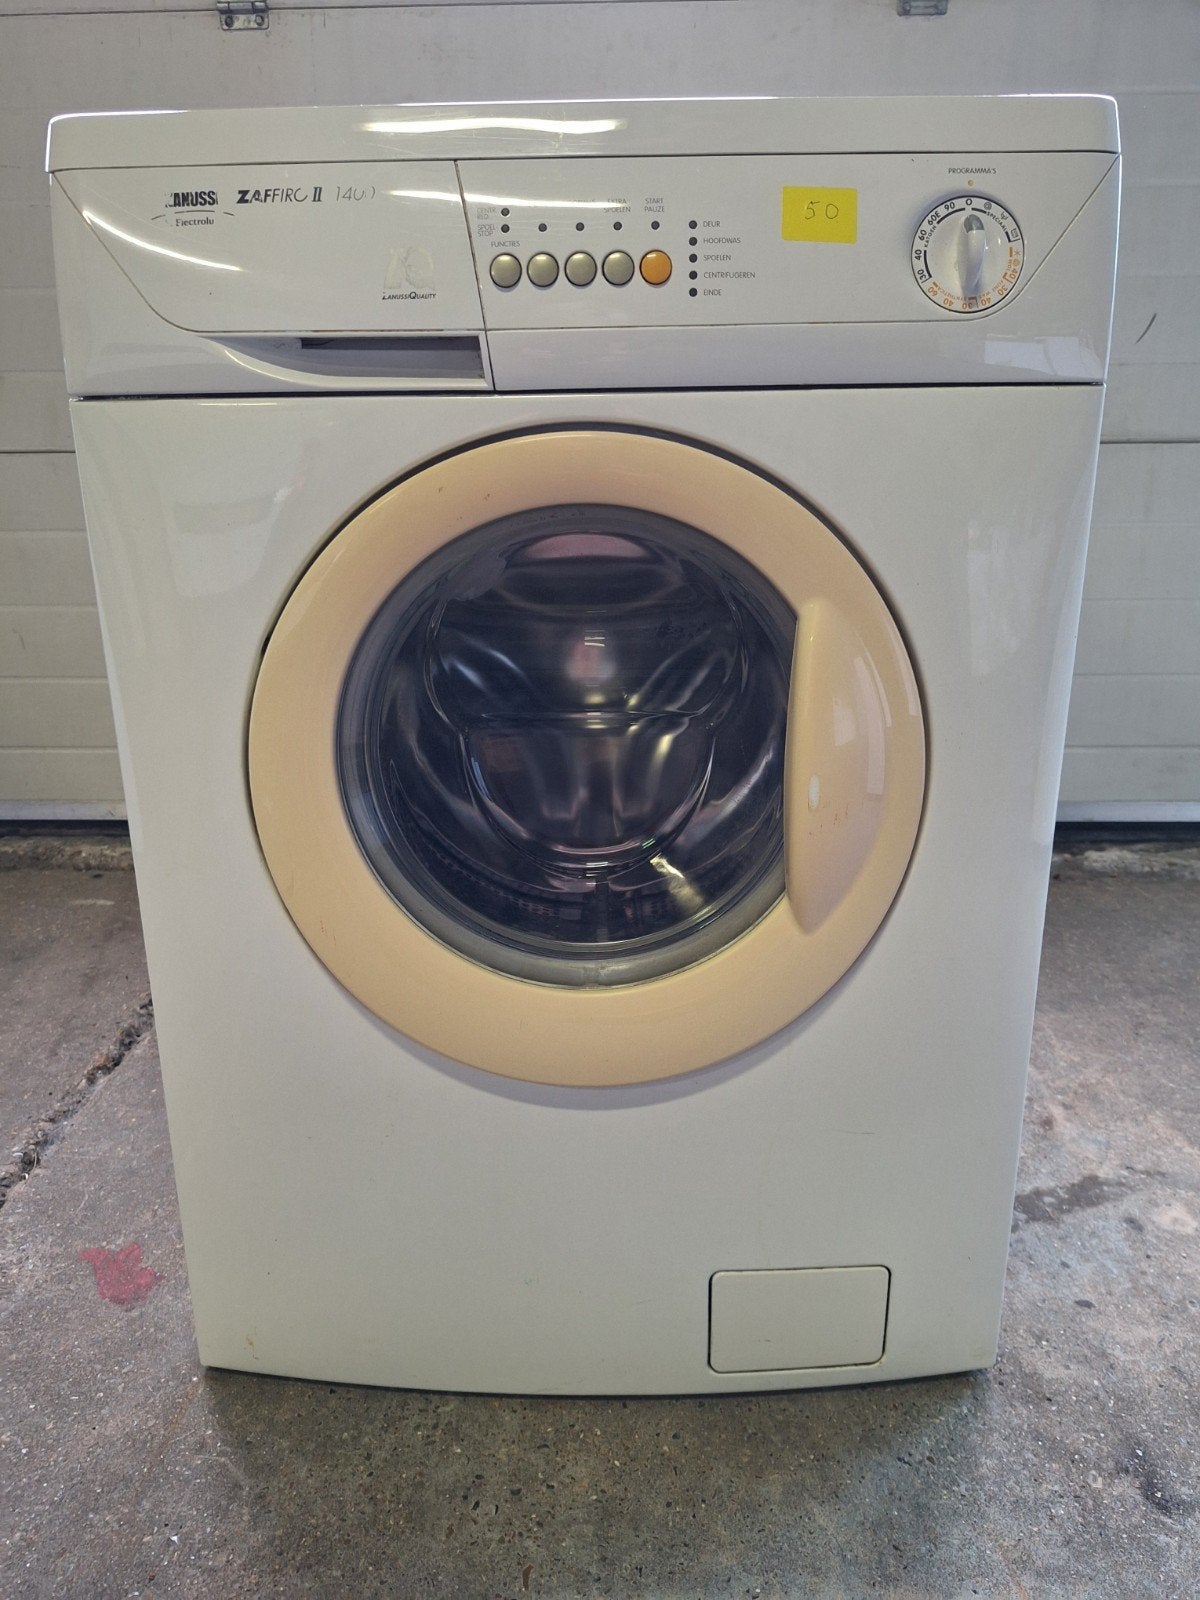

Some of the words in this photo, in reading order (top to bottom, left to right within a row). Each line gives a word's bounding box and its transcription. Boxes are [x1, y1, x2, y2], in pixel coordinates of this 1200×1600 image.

[948, 167, 997, 175] PROGRAMMA'S
[603, 206, 631, 214] SPOELEN
[644, 205, 665, 213] PAUZE
[944, 201, 956, 211] 90
[927, 211, 941, 226] 60E
[986, 211, 1007, 232] SPECIAAL
[702, 220, 721, 228] DEUR
[918, 229, 928, 241] 60
[923, 225, 937, 248] KATOEN
[490, 240, 521, 248] FUNCTIES
[914, 249, 922, 261] 40
[703, 271, 756, 279] CENTRIFUGEREN
[917, 269, 927, 281] 30
[703, 288, 722, 296] EINDE
